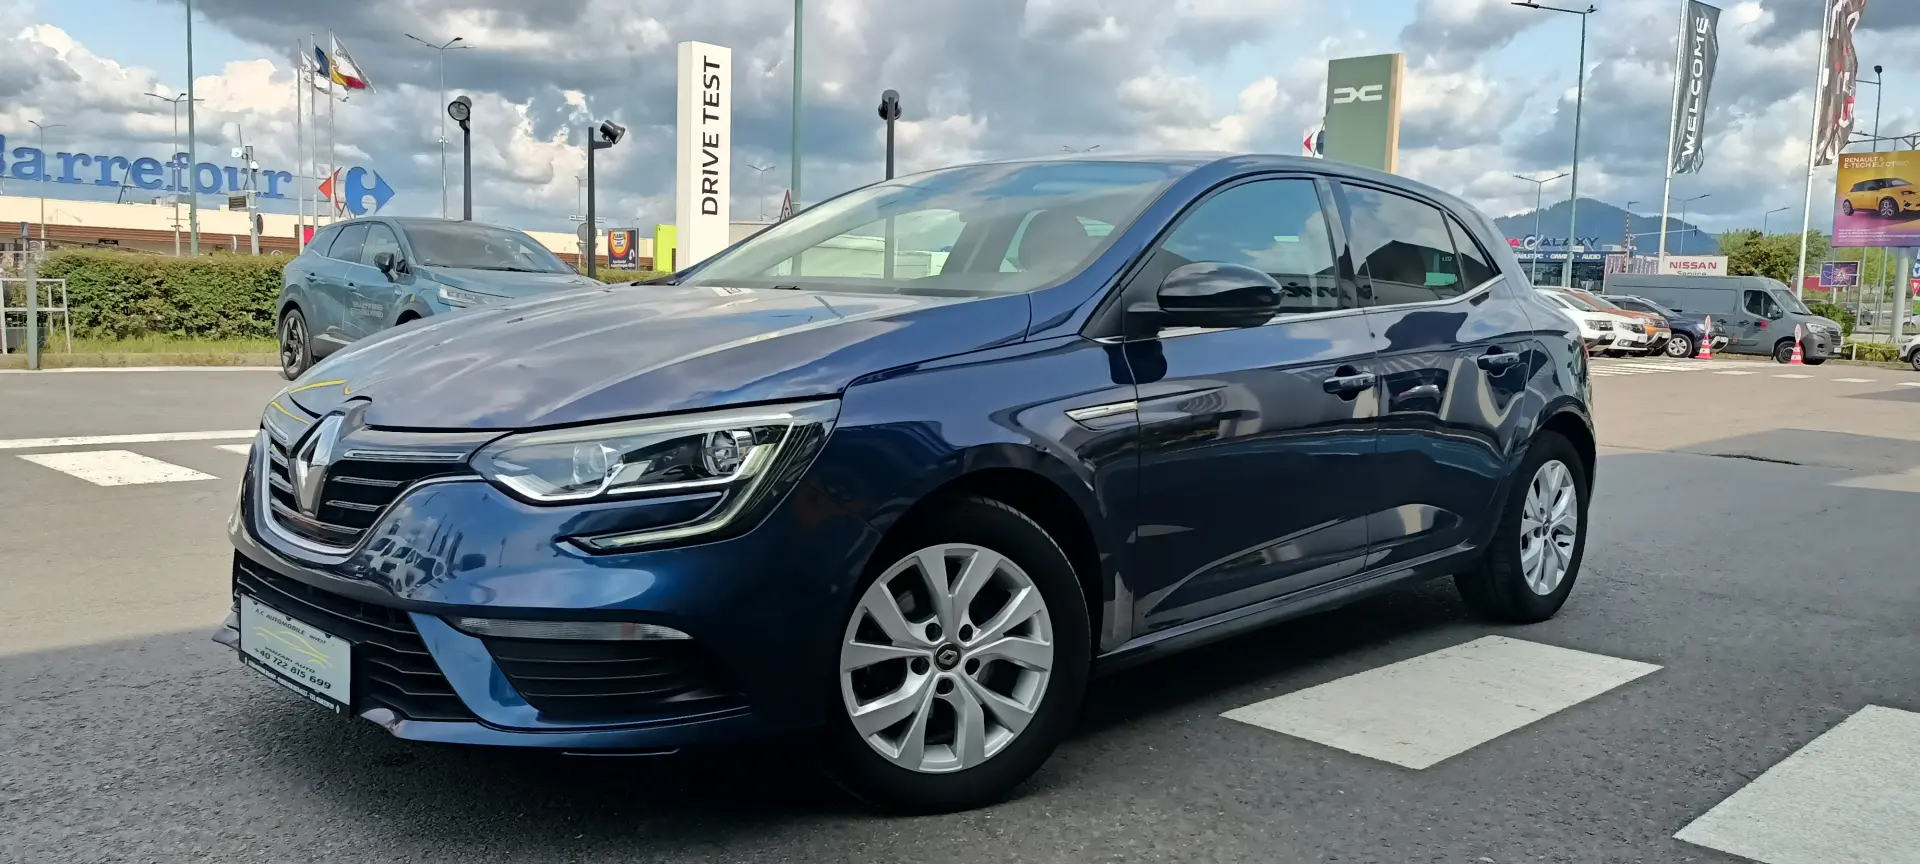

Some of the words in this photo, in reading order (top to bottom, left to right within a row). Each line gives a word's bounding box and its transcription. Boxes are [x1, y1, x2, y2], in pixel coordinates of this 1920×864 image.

[702, 55, 720, 125] TEST
[1682, 16, 1709, 157] WELCOME
[0, 133, 292, 199] arrefour
[701, 131, 719, 216] DRIVE
[1669, 261, 1717, 270] NISSAN
[265, 614, 306, 636] AUTOMOBILE
[273, 657, 288, 670] 722
[290, 666, 306, 679] 815
[309, 675, 332, 690] 699
[294, 661, 316, 674] AUTO
